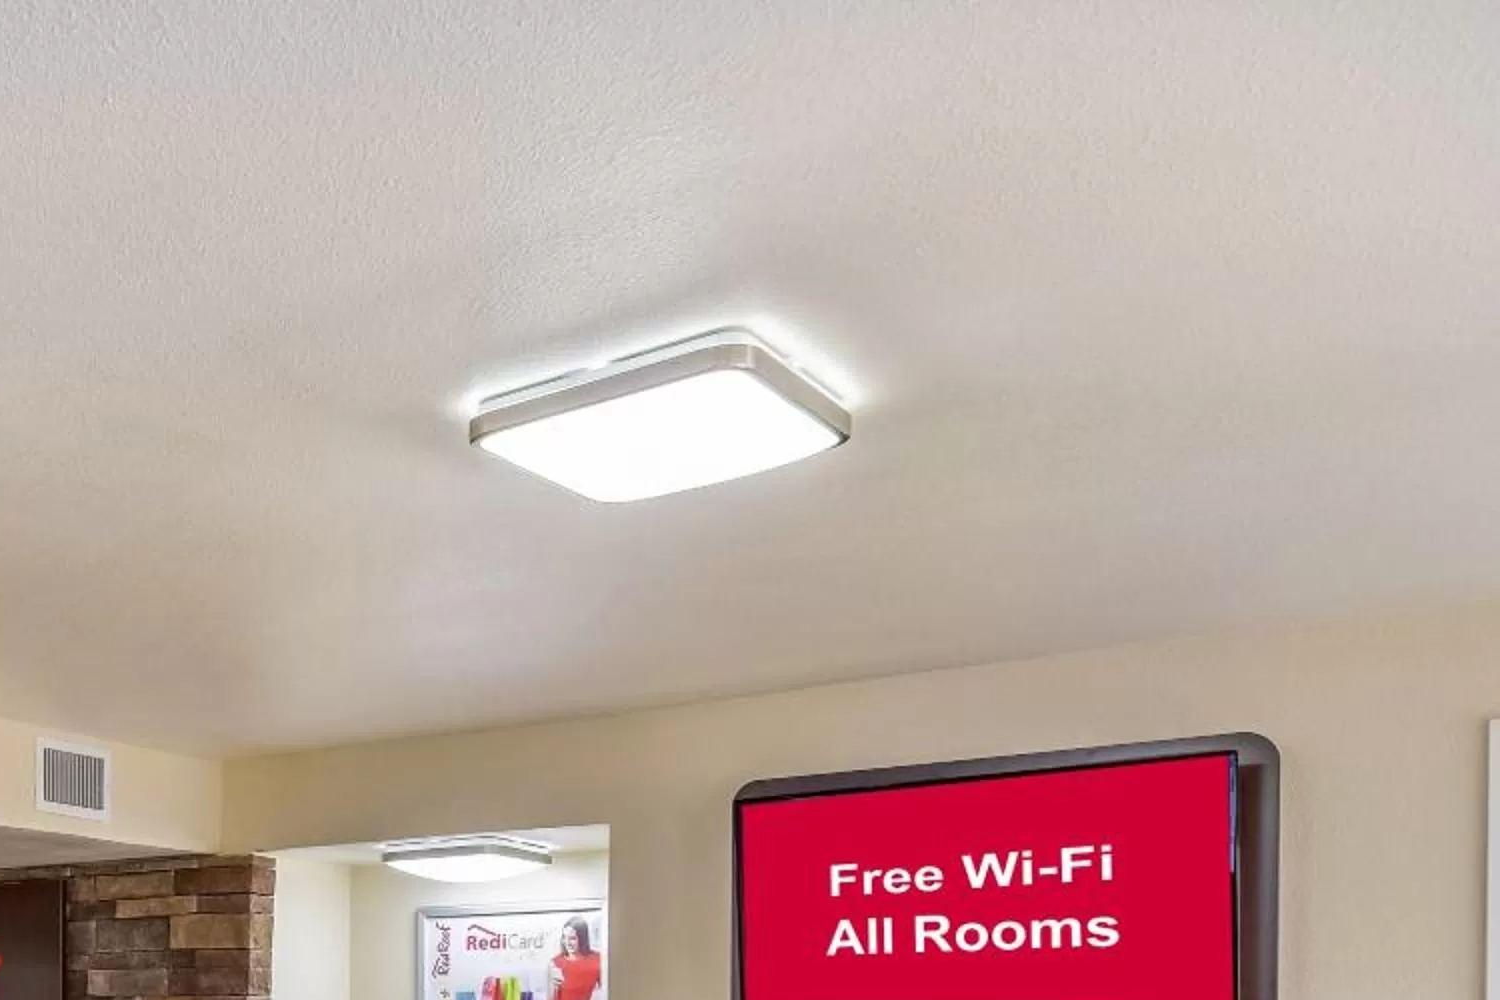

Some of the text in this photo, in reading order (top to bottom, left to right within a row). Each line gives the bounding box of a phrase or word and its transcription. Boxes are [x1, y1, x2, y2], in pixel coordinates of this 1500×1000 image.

[829, 844, 1113, 897] Free Wi-Fi
[467, 933, 545, 950] RediCard
[826, 914, 1120, 956] All Rooms
